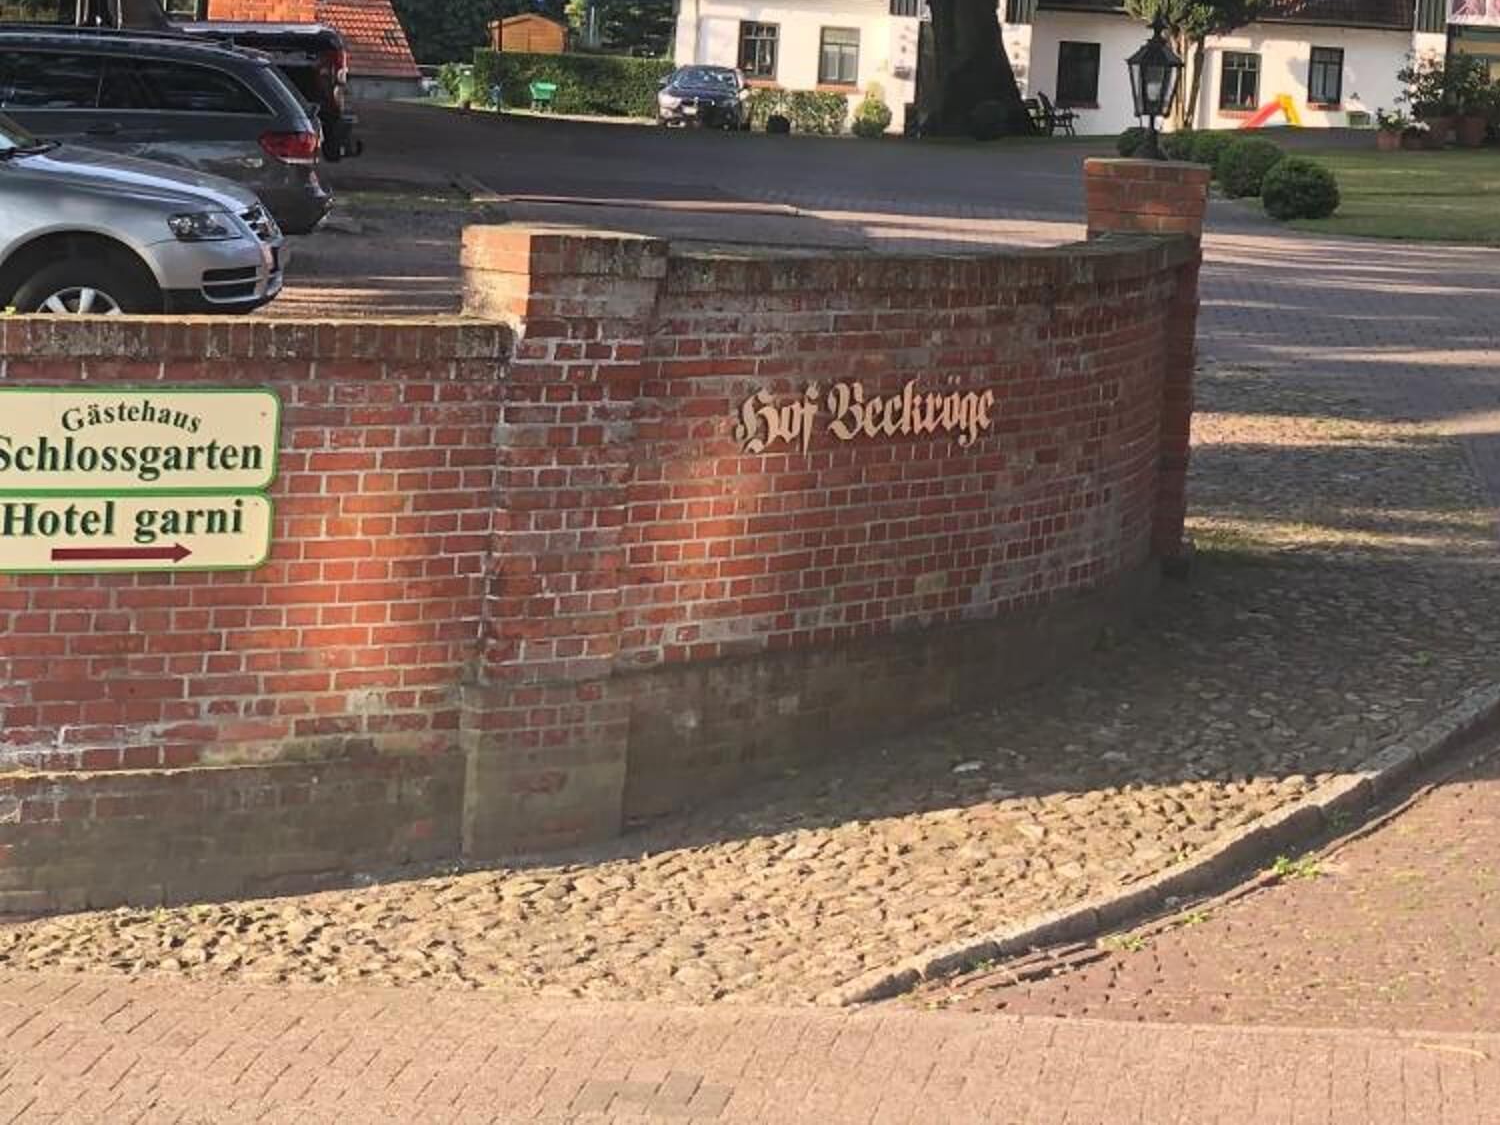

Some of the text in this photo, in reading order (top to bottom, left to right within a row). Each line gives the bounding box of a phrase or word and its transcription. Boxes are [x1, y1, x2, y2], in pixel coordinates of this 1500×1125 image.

[61, 400, 202, 433] Gästehaus
[735, 384, 818, 458] Hof
[1, 499, 243, 543] Hotel garni
